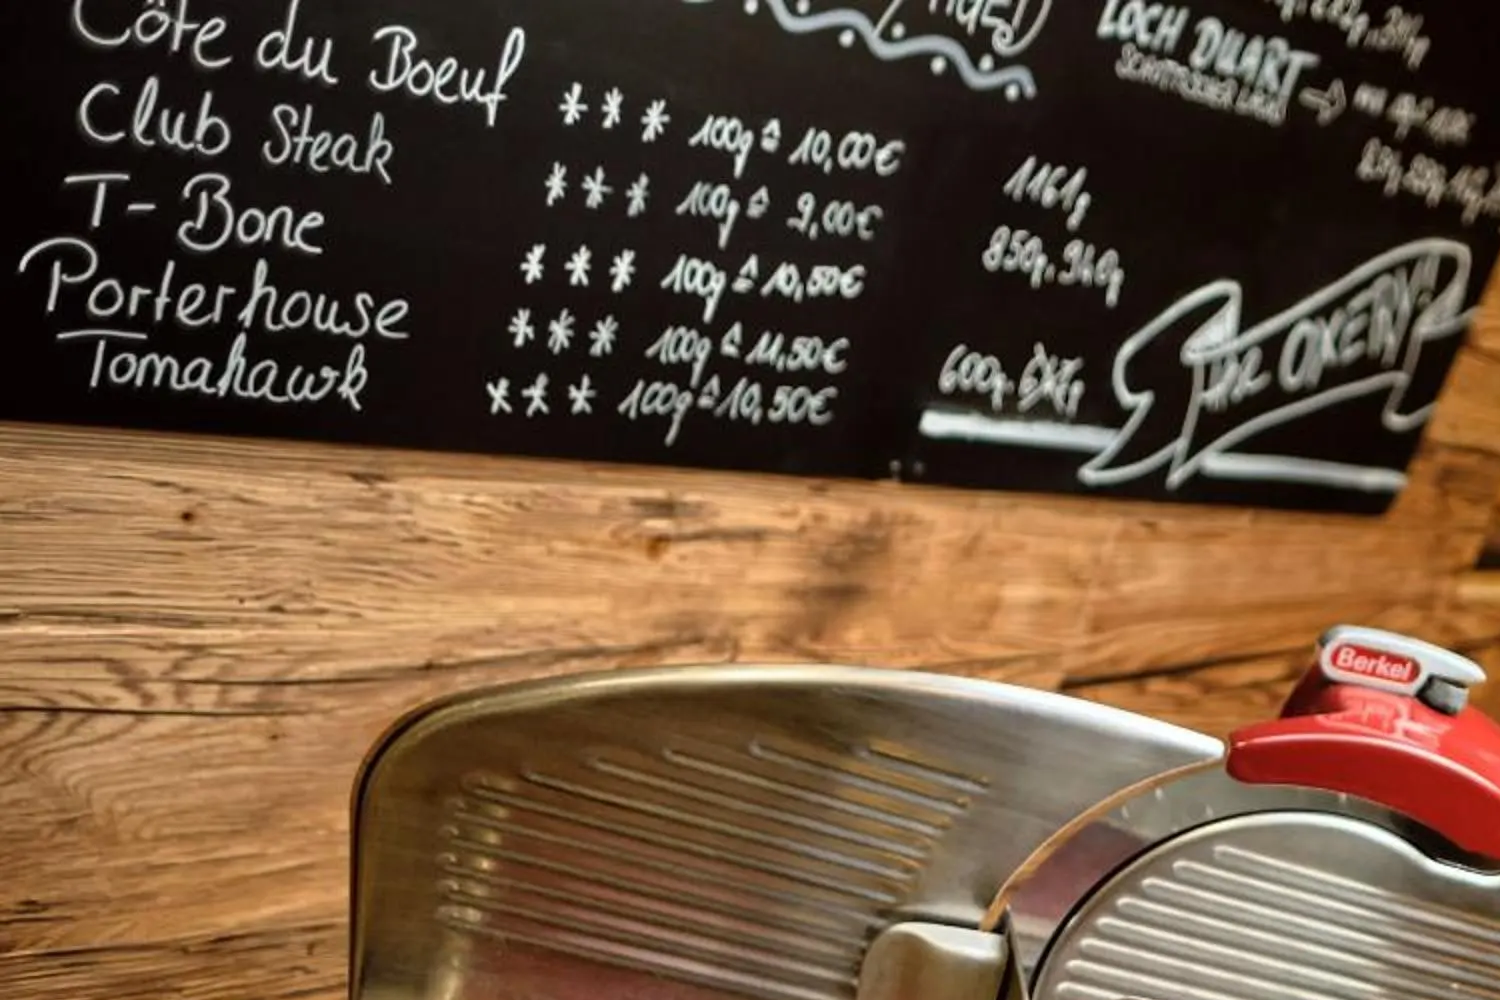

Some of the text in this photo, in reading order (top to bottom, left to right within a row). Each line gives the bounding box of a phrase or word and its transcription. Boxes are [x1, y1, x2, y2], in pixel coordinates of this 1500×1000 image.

[1097, 0, 1189, 52] LOCH
[257, 0, 338, 85] du
[370, 26, 525, 127] Boeuf
[80, 76, 392, 184] Club Steak
[688, 114, 754, 180] 100g
[788, 127, 907, 176] 10,00€
[675, 181, 741, 250] 100g
[19, 238, 410, 339] Porterhouse
[660, 254, 727, 324] 100g
[760, 262, 866, 304] 10,50€
[57, 329, 369, 411] Tomahawk
[644, 325, 712, 388] 100g
[617, 379, 694, 446] 100g
[714, 376, 839, 426] 10,50€
[1335, 646, 1413, 681] Berkel
